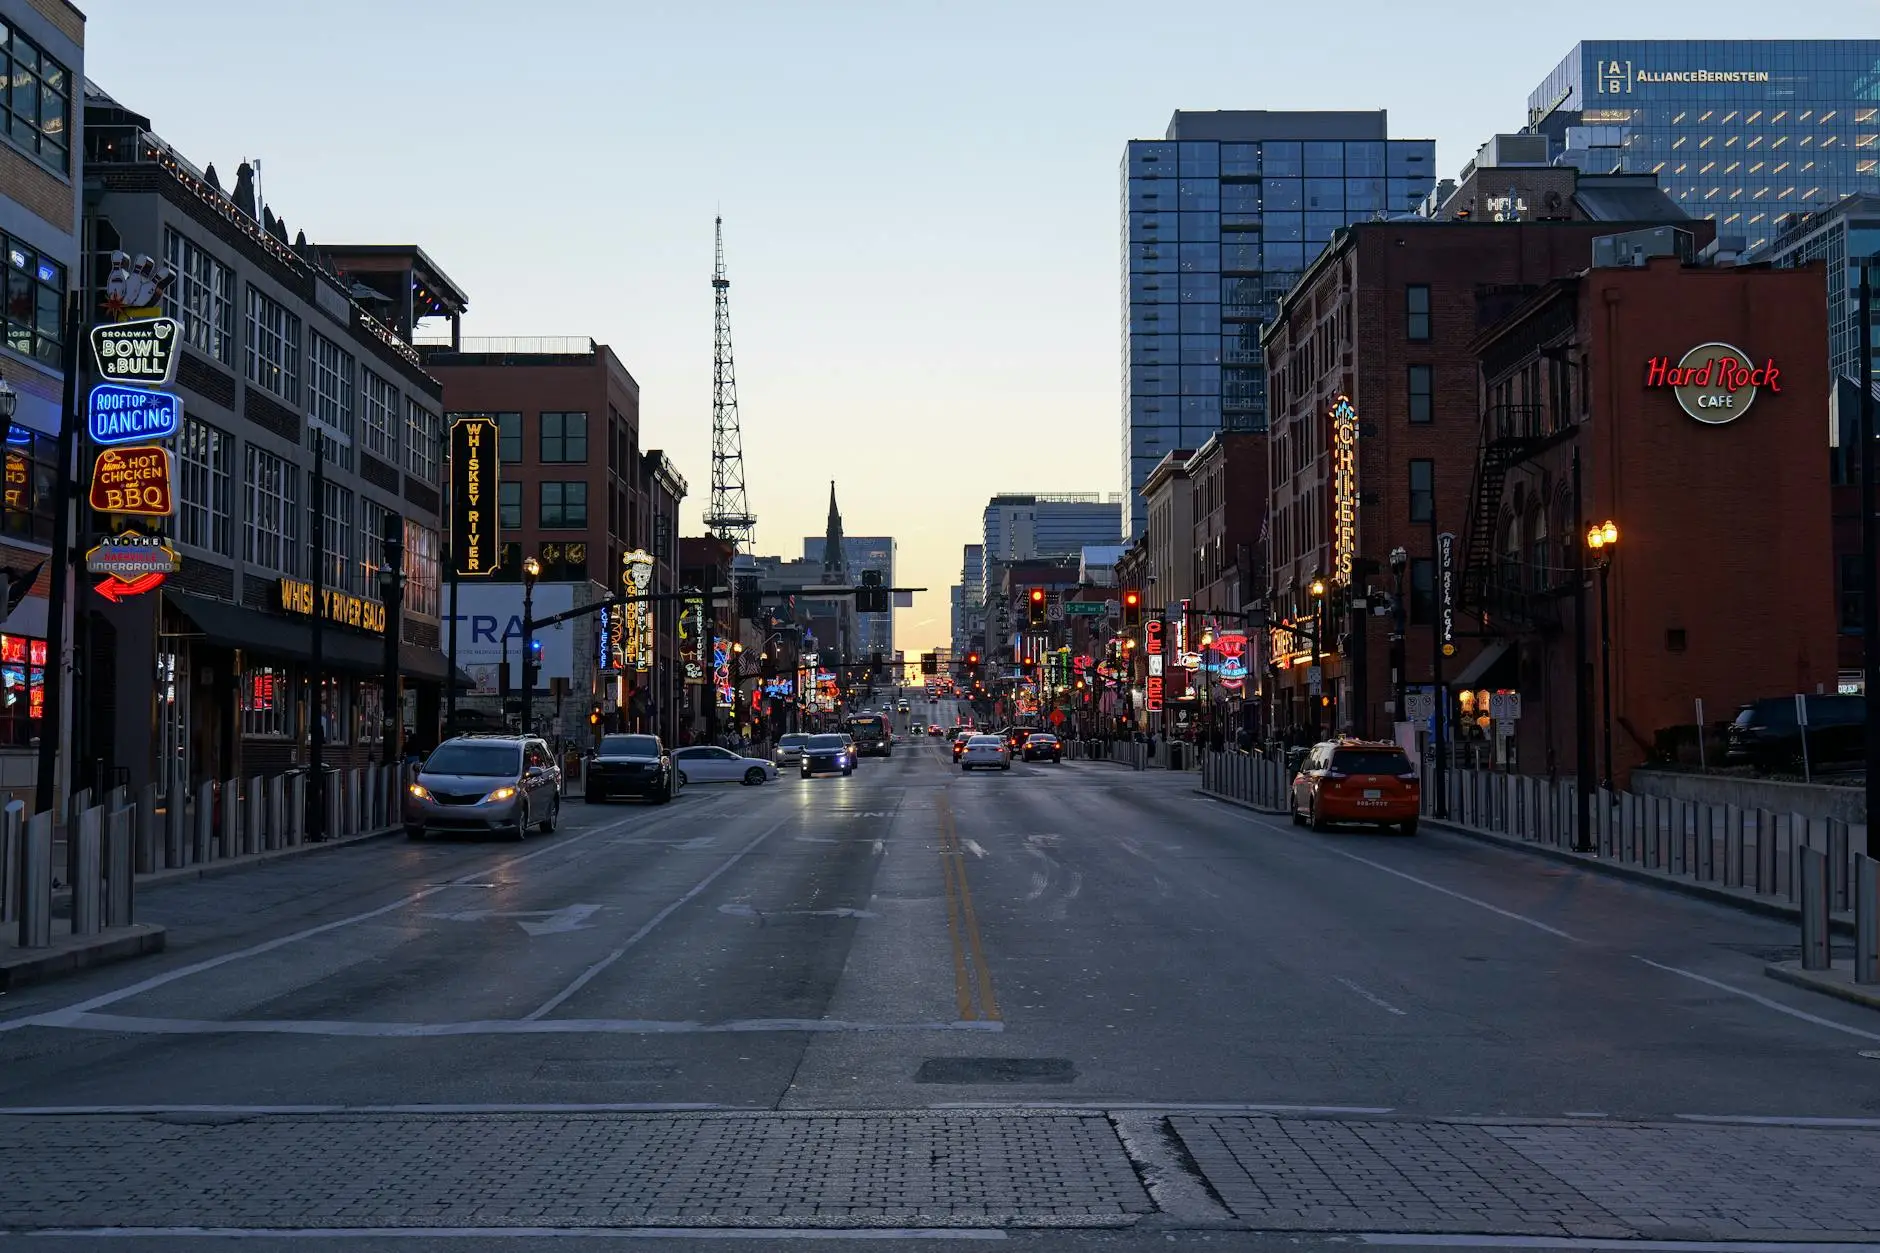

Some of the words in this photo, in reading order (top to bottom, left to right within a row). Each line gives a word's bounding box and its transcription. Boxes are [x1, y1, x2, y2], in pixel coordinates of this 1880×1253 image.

[1608, 60, 1621, 74] A
[1610, 81, 1621, 93] B
[102, 340, 165, 357] BOWL
[117, 358, 164, 374] BULL
[1647, 356, 1713, 387] Hard
[1717, 357, 1782, 392] Rock
[97, 394, 147, 411] ROOFTOP
[1697, 395, 1733, 408] CAFE
[97, 407, 171, 436] DANCING
[129, 455, 159, 469] HOT
[466, 423, 482, 506] WHISKEY
[101, 467, 161, 484] CHICKEN
[105, 486, 164, 509] BBQ
[1339, 424, 1352, 574] CHIEFS
[103, 538, 119, 546] AT
[132, 538, 159, 546] THE
[468, 510, 480, 570] RIVER
[1443, 538, 1451, 568] Hard
[333, 592, 361, 627] RIVER
[1147, 621, 1162, 654] OLE
[1148, 677, 1162, 710] RED
[1838, 684, 1858, 694] OPEN
